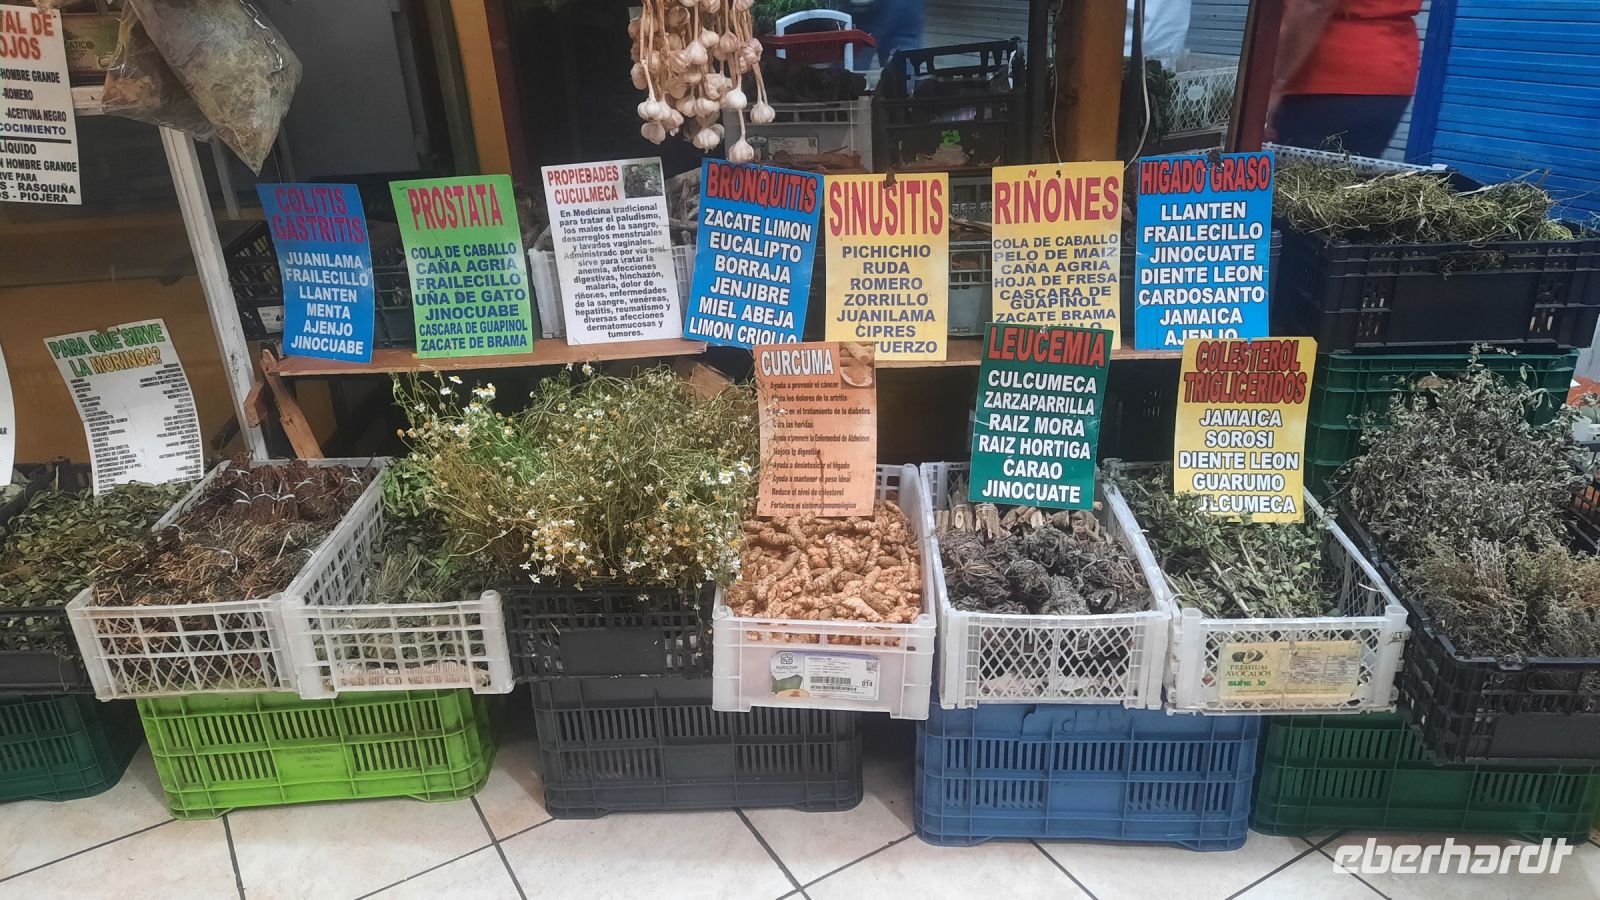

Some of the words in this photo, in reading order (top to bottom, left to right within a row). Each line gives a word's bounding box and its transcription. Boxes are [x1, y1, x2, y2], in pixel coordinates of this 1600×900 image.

[31, 13, 54, 36] DE
[32, 70, 60, 83] GRANDE
[43, 110, 66, 122] NEGRO
[6, 158, 41, 170] HOMBRE
[44, 161, 77, 172] GRANDE
[16, 172, 37, 182] PARA
[548, 165, 619, 186] PROPIEDADES
[1140, 160, 1206, 194] HIGADO
[1210, 156, 1271, 192] GRASO
[18, 183, 76, 193] RASQUIÑA
[20, 192, 68, 202] PIOJERA
[555, 185, 618, 204] CUCULMECA
[706, 163, 818, 214] BRONQUITIS
[995, 170, 1119, 224] RIÑONES
[275, 186, 347, 214] COLITIS
[408, 184, 503, 230] PROSTATA
[829, 179, 943, 236] SINUSITIS
[573, 207, 610, 217] Medicina
[613, 203, 657, 213] tradicional
[1161, 202, 1247, 221] LLANTEN
[272, 216, 364, 243] GASTRITIS
[559, 219, 577, 227] para
[616, 214, 661, 222] paludismo,
[704, 208, 761, 234] ZACATE
[764, 218, 811, 242] LIMON
[562, 233, 612, 242] desarreglos
[613, 230, 662, 239] menstruales
[994, 238, 1028, 249] COLA
[1034, 237, 1050, 247] DE
[1056, 234, 1118, 246] CABALLO
[1144, 223, 1263, 243] FRAILECILLO
[412, 247, 442, 259] COLA
[445, 245, 460, 257] DE
[464, 242, 516, 257] CABALLO
[709, 231, 802, 263] EUCALIPTO
[842, 245, 931, 258] PICHICHIO
[994, 251, 1038, 262] PELO
[1045, 250, 1067, 260] DE
[1074, 247, 1118, 259] MAIZ
[1150, 244, 1255, 264] JINOCUATE
[287, 252, 363, 268] JUANILAMA
[416, 259, 461, 274] CAÑA
[467, 258, 518, 272] AGRIA
[863, 262, 910, 274] RUDA
[1002, 261, 1049, 275] CAÑA
[1055, 261, 1110, 272] AGRIA
[286, 268, 368, 286] FRAILECILLO
[715, 255, 791, 284] BORRAJA
[1141, 267, 1208, 285] DIENTE
[1214, 265, 1263, 282] LEON
[416, 273, 521, 290] FRAILECILLO
[850, 277, 923, 290] ROMERO
[994, 277, 1036, 288] HOJA
[1042, 276, 1061, 286] DE
[1067, 273, 1117, 284] FRESA
[300, 286, 357, 302] LLANTEN
[415, 291, 450, 306] UÑA
[455, 291, 476, 304] DE
[481, 288, 526, 302] GATO
[710, 277, 790, 306] JENJIBRE
[844, 293, 928, 306] ZORRILLO
[1000, 288, 1085, 300] CASCARA
[1089, 286, 1111, 297] DE
[1139, 287, 1265, 306] CARDOSANTO
[307, 303, 350, 319] MENTA
[425, 305, 519, 320] JINOCUABE
[699, 296, 737, 318] MIEL
[741, 304, 794, 329] ABEJA
[1010, 297, 1101, 310] GUAPINOL
[584, 315, 617, 323] diversas
[620, 311, 664, 320] afecciones
[837, 310, 936, 322] JUANILAMA
[996, 311, 1056, 323] ZACATE
[1062, 309, 1116, 321] BRAMA
[1160, 307, 1243, 325] JAMAICA
[303, 320, 352, 336] AJENJO
[419, 322, 462, 336] CASCARA
[466, 322, 477, 333] DE
[480, 319, 528, 332] GUAPINOL
[587, 321, 656, 331] dermatomucosas
[608, 330, 643, 338] tumores.
[689, 317, 734, 341] LIMON
[855, 325, 915, 337] CIPRES
[48, 337, 92, 359] PARA
[89, 331, 123, 353] QUE
[120, 323, 165, 347] SIRVE
[291, 336, 363, 355] JINOCUABE
[421, 338, 465, 351] ZACATE
[469, 337, 484, 348] DE
[488, 335, 527, 347] BRAMA
[988, 326, 1105, 367] LEUCEMIA
[69, 358, 93, 378] LA
[89, 346, 162, 374] MORINGA?
[761, 349, 834, 377] CURCUMA
[1196, 340, 1301, 372] COLESTEROL
[770, 382, 786, 390] Ayuda
[792, 382, 813, 390] prevenir
[988, 370, 1097, 394] CULCUMECA
[1184, 372, 1308, 404] TRIGLICERIDOS
[984, 392, 1095, 416] ZARZAPARRILLA
[989, 414, 1030, 432] RAIZ
[1035, 418, 1085, 437] MORA
[1200, 409, 1282, 427] JAMAICA
[979, 435, 1016, 454] RAIZ
[1020, 438, 1091, 459] HORTIGA
[1205, 430, 1274, 448] SOROSI
[1003, 459, 1063, 479] CARAO
[1179, 452, 1246, 469] DIENTE
[1251, 452, 1299, 470] LEON
[772, 476, 788, 484] Ayuda
[1193, 473, 1285, 492] GUARUMO
[982, 480, 1081, 503] JINOCUATE
